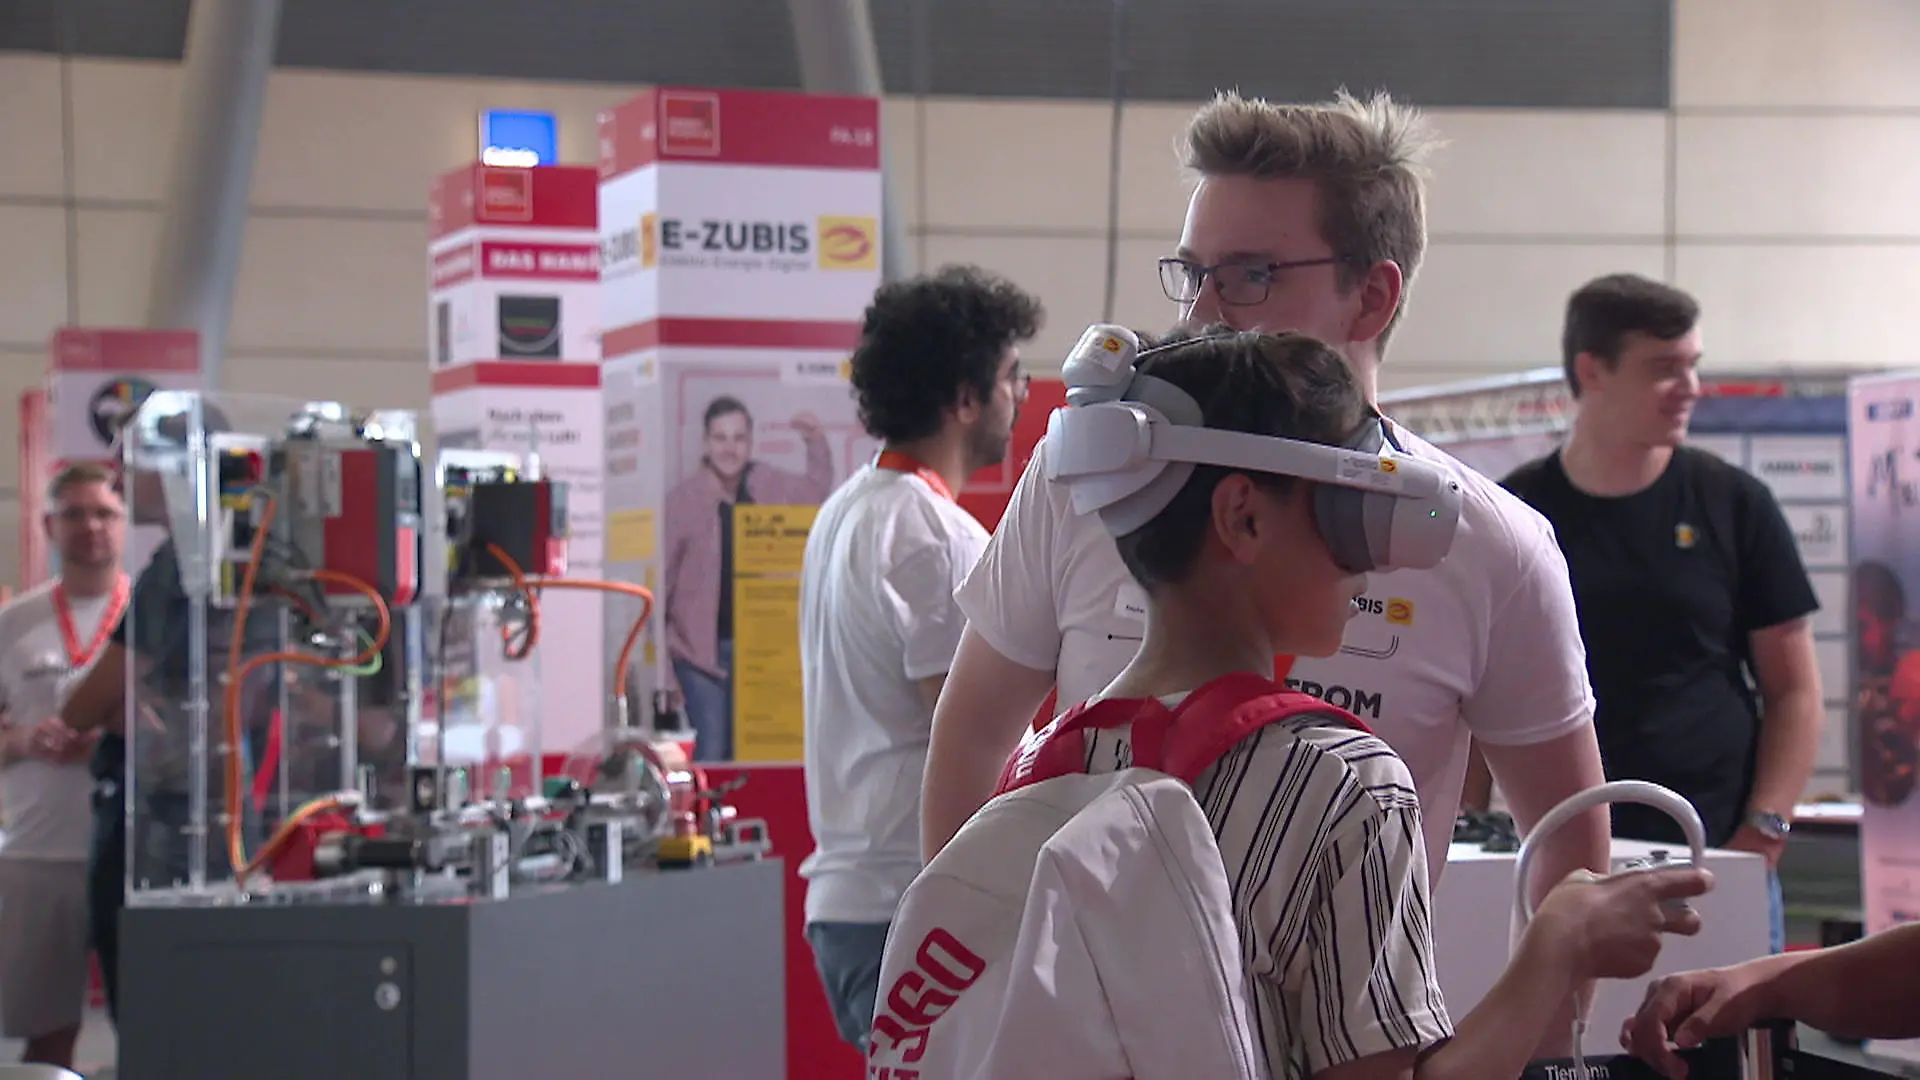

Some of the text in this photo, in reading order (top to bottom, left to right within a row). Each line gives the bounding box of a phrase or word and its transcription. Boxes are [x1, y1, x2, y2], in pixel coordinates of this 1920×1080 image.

[661, 219, 811, 254] E-ZUBIS
[1351, 596, 1383, 615] BIS
[1544, 1064, 1610, 1080] Tiemnn
